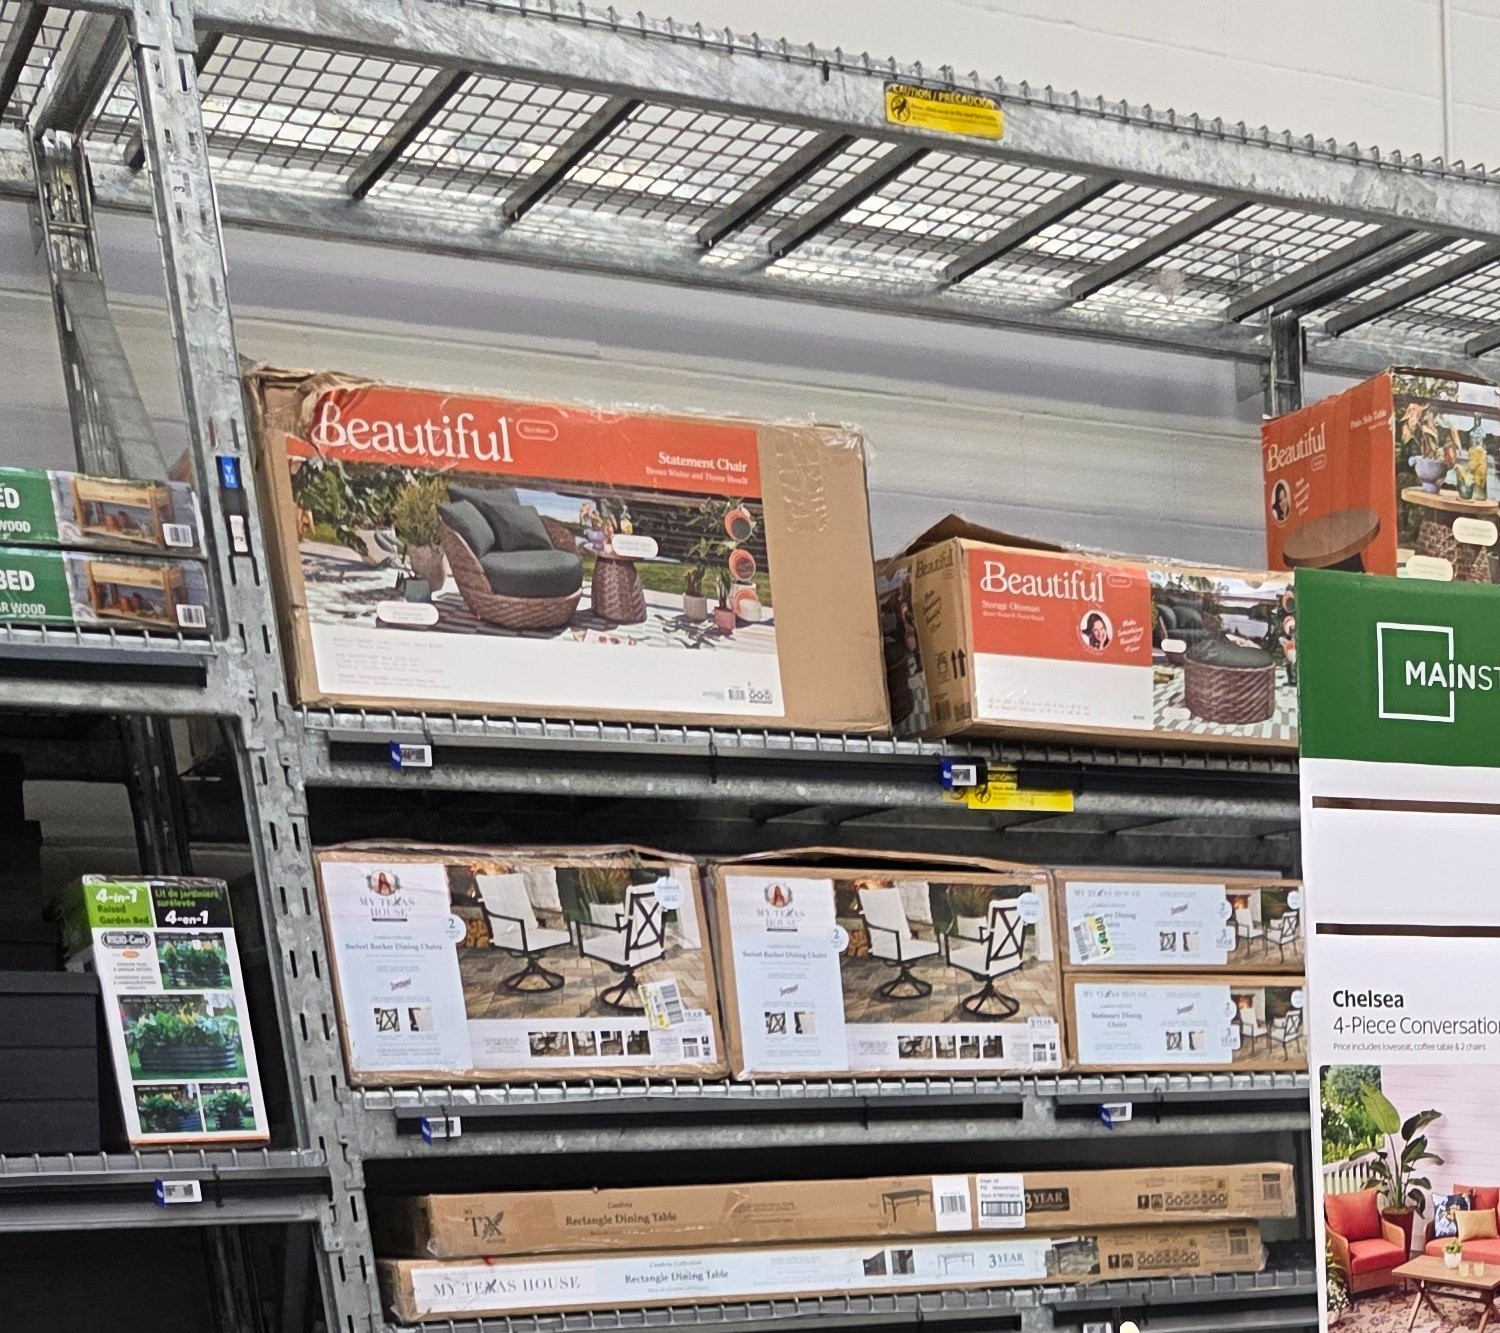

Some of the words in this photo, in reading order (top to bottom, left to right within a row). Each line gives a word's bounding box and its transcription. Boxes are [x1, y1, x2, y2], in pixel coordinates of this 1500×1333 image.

[312, 400, 514, 463] Beautiful
[1266, 422, 1326, 472] Beautiful
[658, 451, 714, 469] Statement
[716, 457, 748, 473] Chair
[980, 560, 1105, 603] Beautiful
[10, 606, 46, 616] WOOD
[96, 888, 138, 903] 4-in-1
[100, 915, 131, 925] Garden
[165, 910, 209, 925] 4-en-1
[448, 918, 456, 929] 2
[1332, 990, 1404, 1008] Chelsea
[1333, 1016, 1396, 1035] 4-Piece
[1333, 1043, 1350, 1051] Price
[1352, 1043, 1382, 1051] includes
[1414, 1043, 1435, 1051] coffee
[1436, 1043, 1454, 1051] table
[1466, 1043, 1486, 1051] chairs
[1032, 1192, 1063, 1204] YEAR
[565, 1214, 613, 1227] Rectangle
[614, 1212, 650, 1226] Dining
[651, 1211, 677, 1223] Table
[989, 1253, 996, 1268] 3
[999, 1253, 1024, 1263] YEAR
[625, 1272, 670, 1284] Rectangle
[671, 1270, 704, 1283] Dining
[706, 1269, 729, 1281] Table
[433, 1283, 456, 1297] MY
[461, 1278, 517, 1296] TEXAS
[522, 1275, 581, 1293] HOUSE
